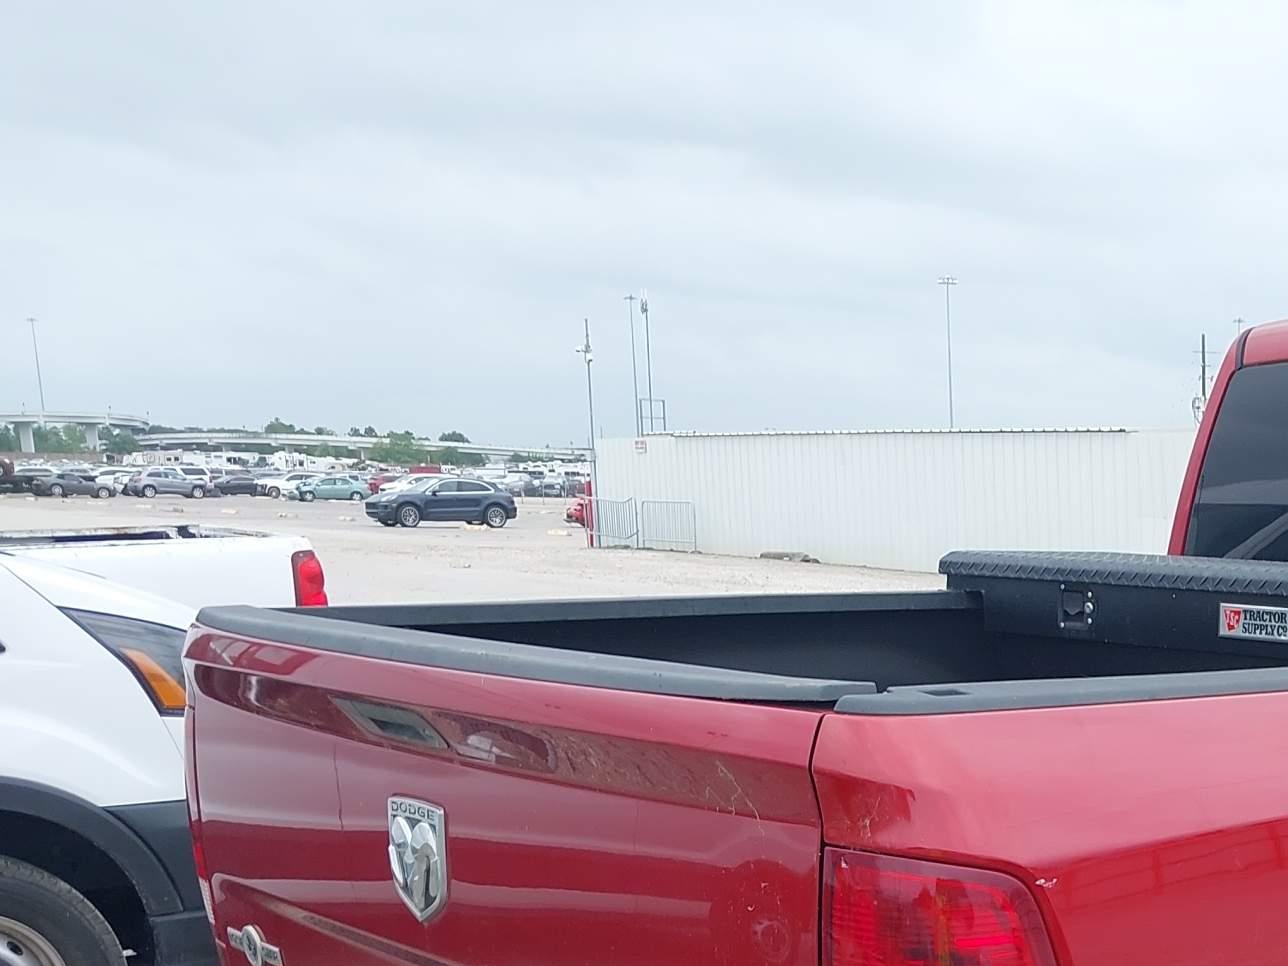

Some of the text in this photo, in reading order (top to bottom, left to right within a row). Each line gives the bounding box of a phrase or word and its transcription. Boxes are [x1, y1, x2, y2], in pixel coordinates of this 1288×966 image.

[1242, 609, 1288, 624] TRACTOR
[1242, 622, 1277, 637] SUPPLY
[391, 801, 436, 821] DODGE
